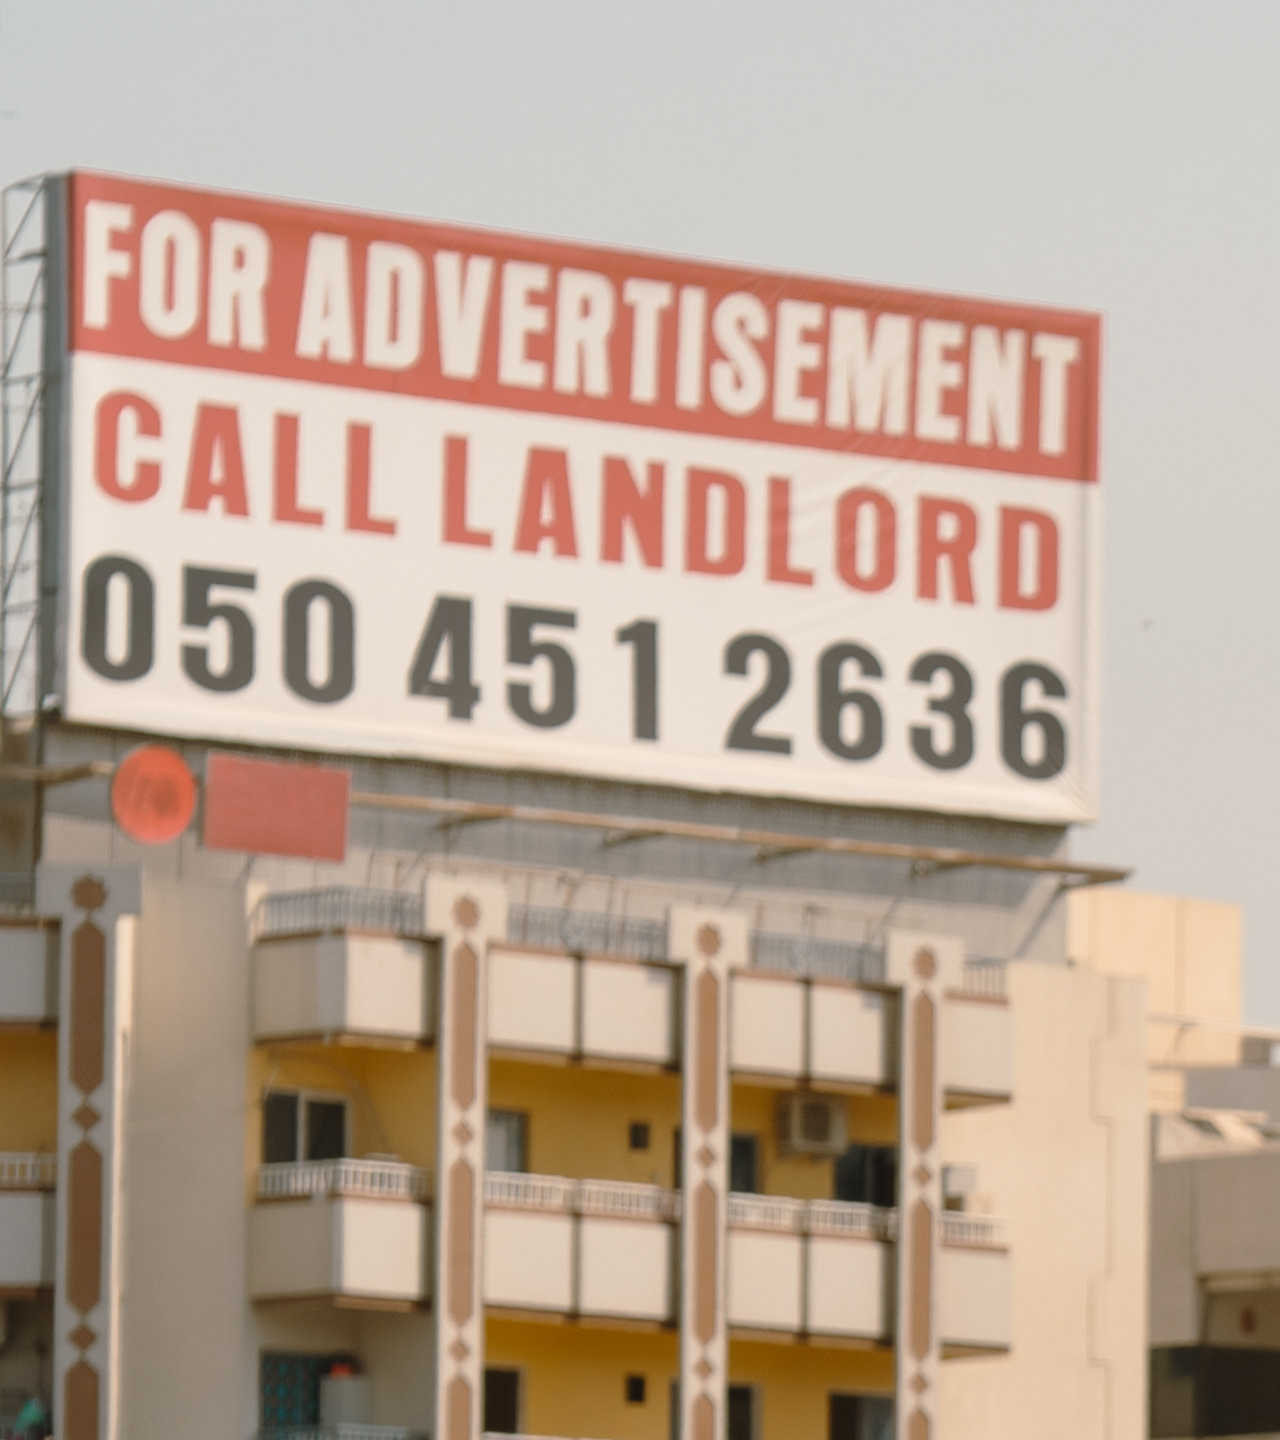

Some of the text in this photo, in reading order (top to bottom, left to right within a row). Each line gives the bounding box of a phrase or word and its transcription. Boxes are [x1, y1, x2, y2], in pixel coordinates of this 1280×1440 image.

[82, 199, 1081, 457] FOR ADVERTISEMENT
[93, 389, 1060, 613] CALL LANDLORD
[81, 555, 1068, 780] 050 451 2636
